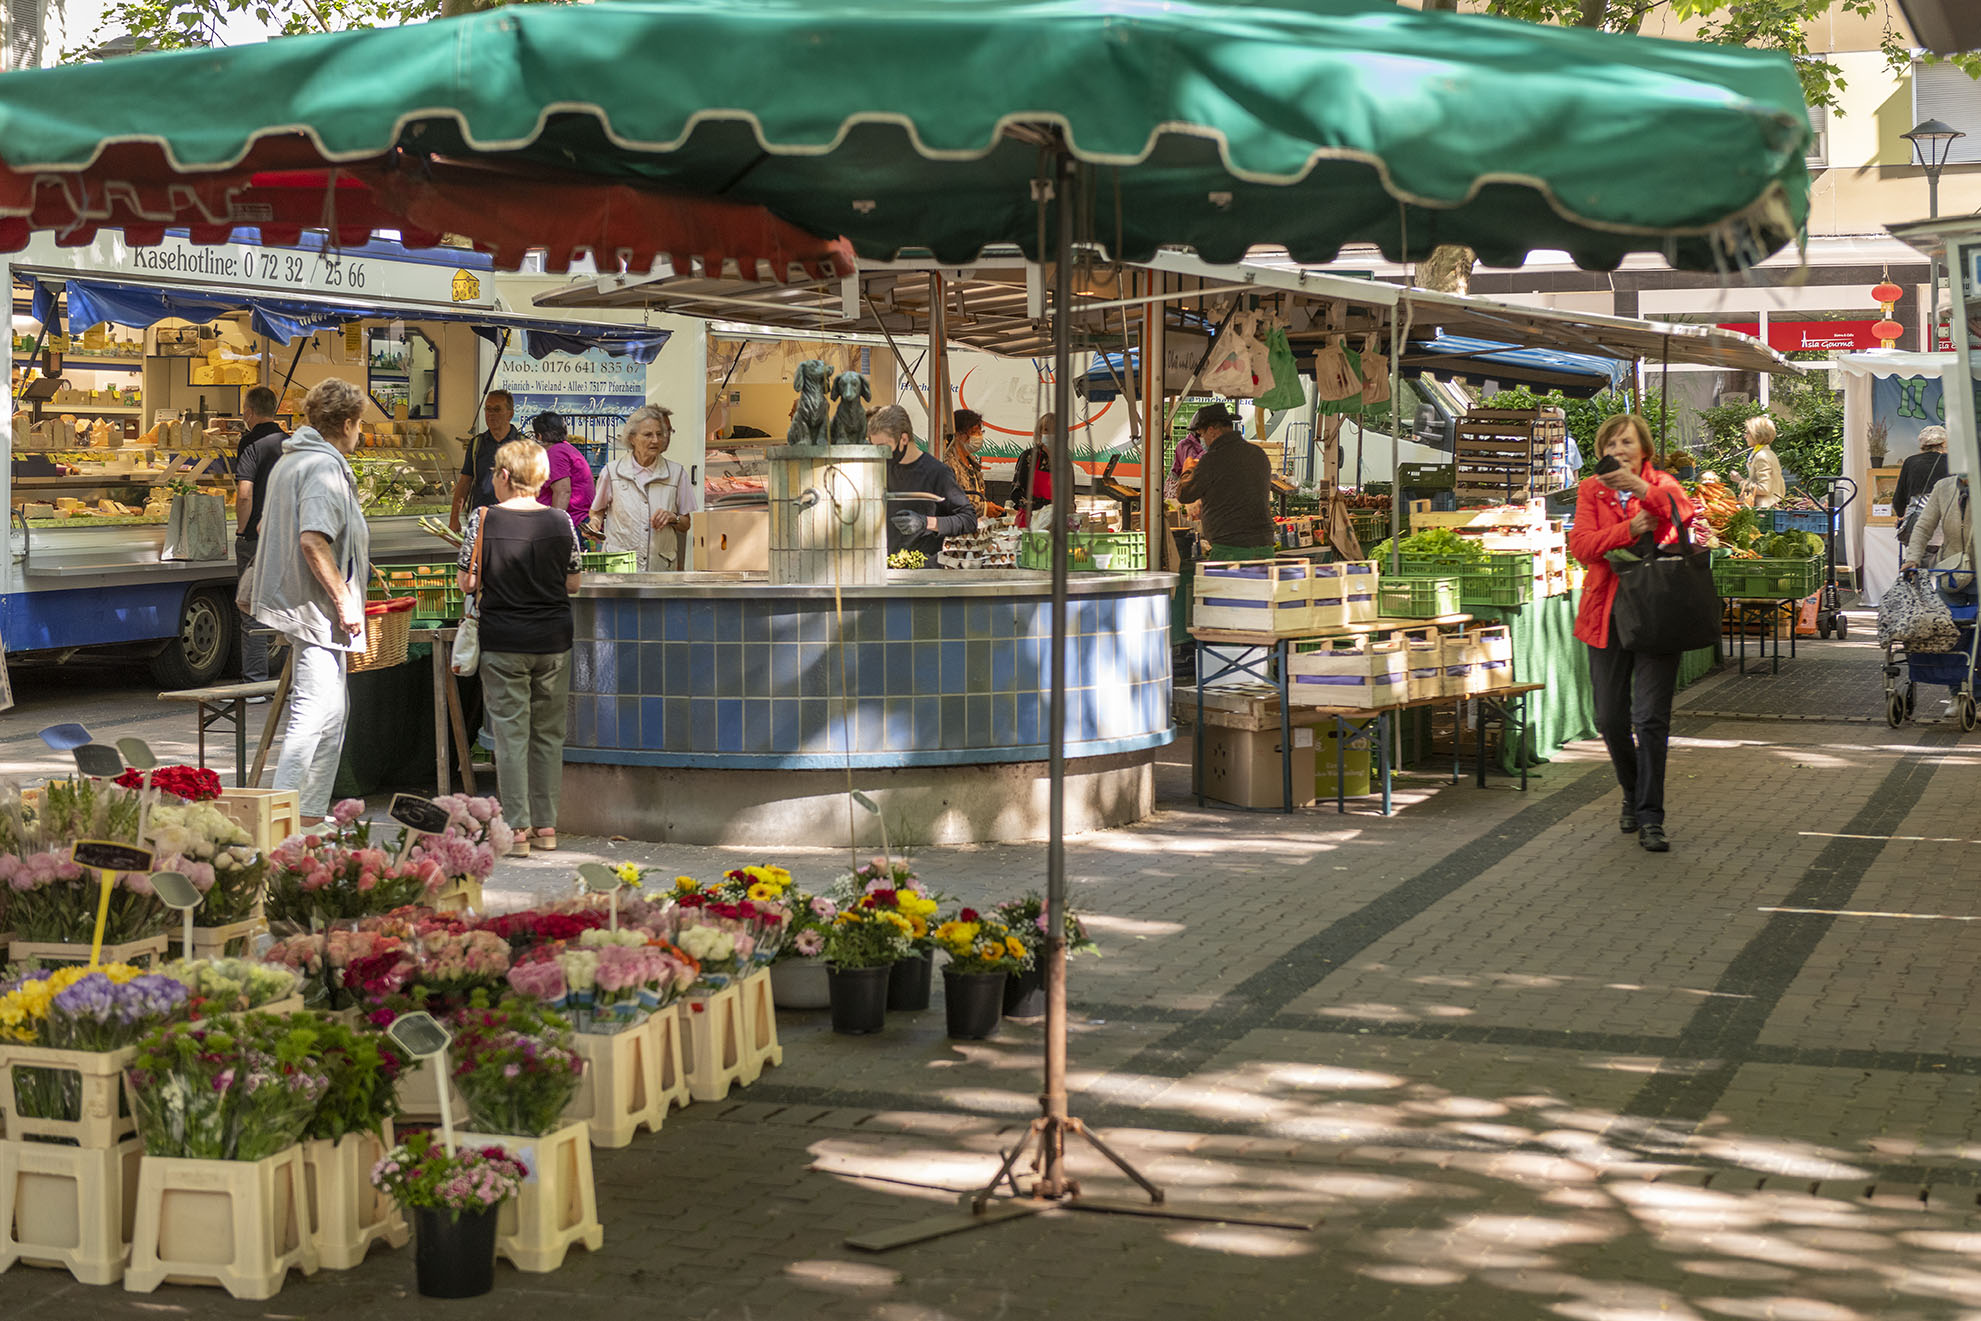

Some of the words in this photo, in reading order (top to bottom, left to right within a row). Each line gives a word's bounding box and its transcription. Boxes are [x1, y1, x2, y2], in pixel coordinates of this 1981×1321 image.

[244, 251, 254, 278] 0
[260, 254, 279, 280] 72
[285, 256, 304, 282] 32
[324, 260, 343, 286] 25
[348, 262, 366, 288] 66
[1801, 330, 1820, 348] Asia
[1821, 340, 1854, 349] Gourmet
[502, 360, 538, 373] Mob.:
[542, 361, 571, 374] 0176
[574, 362, 596, 374] 641
[600, 362, 622, 374] 835
[626, 362, 640, 375] 67
[502, 380, 530, 392] Heinrich
[535, 381, 562, 392] Wieland
[589, 382, 607, 393] 75177
[608, 382, 642, 393] Pforzheim
[586, 417, 620, 428] FENKOST
